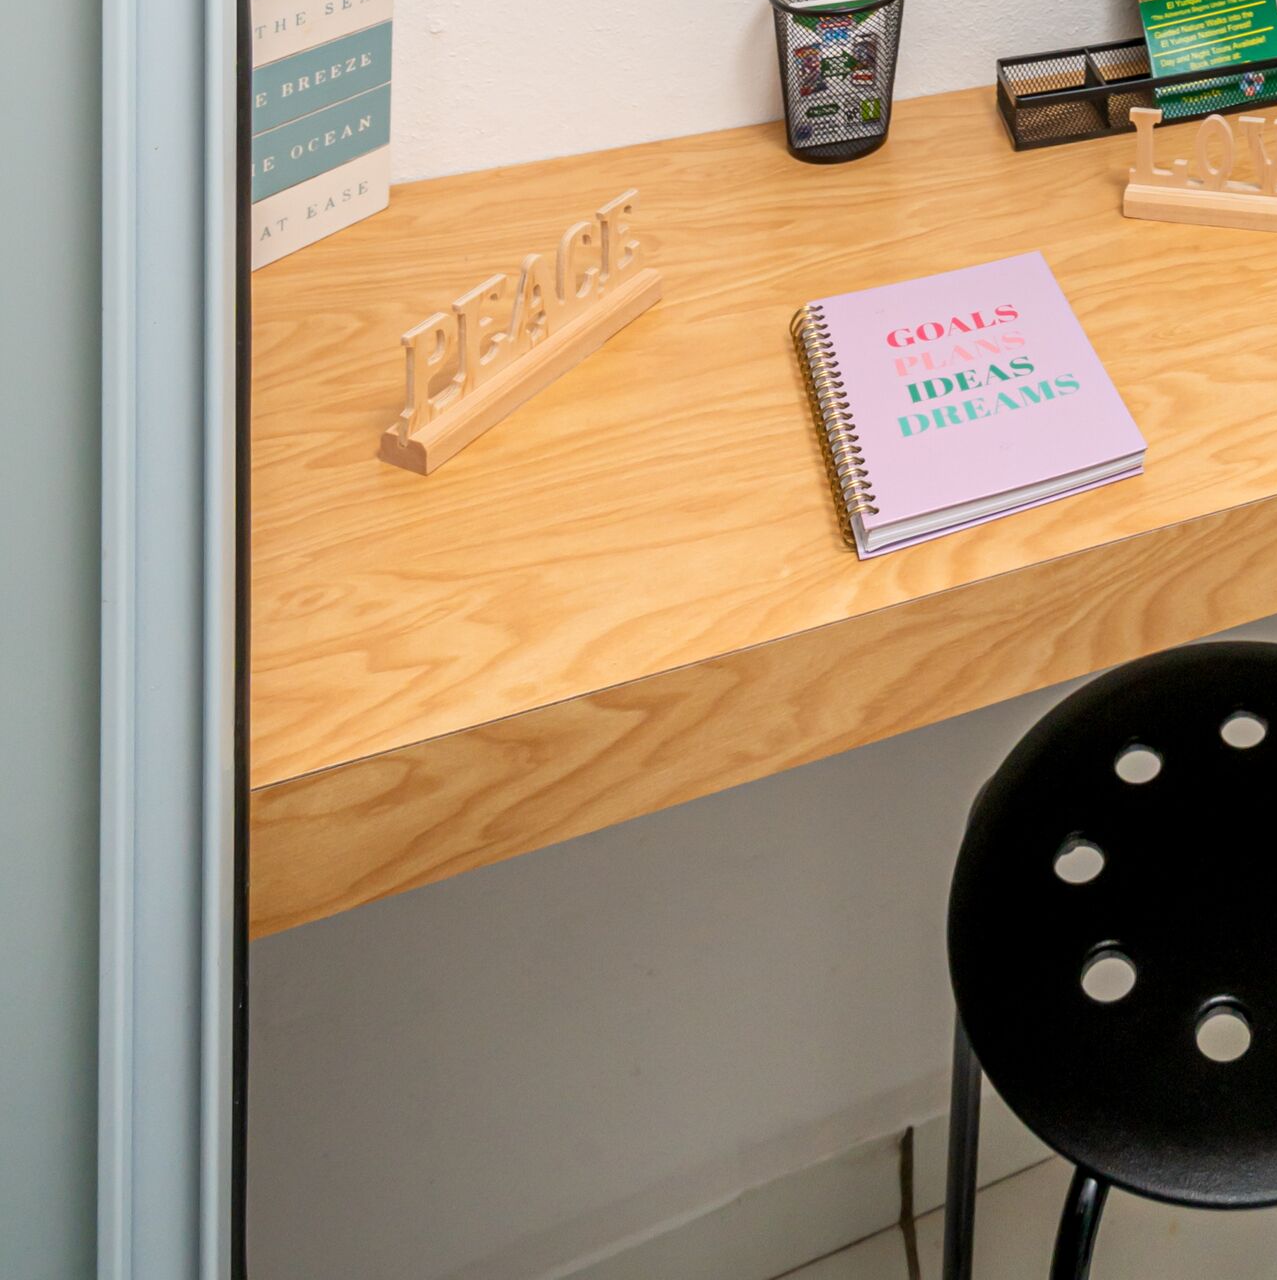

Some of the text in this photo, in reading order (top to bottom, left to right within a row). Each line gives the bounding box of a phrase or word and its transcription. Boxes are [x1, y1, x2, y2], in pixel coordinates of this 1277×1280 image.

[253, 8, 310, 41] THE
[1153, 27, 1181, 40] Guided
[1180, 22, 1206, 33] Nature
[1205, 17, 1228, 27] Walks
[1166, 1, 1174, 10] El
[1197, 26, 1228, 39] National
[280, 52, 373, 99] BREEZE
[1160, 58, 1176, 69] Day
[1175, 54, 1191, 64] and
[1211, 45, 1233, 55] Tours
[290, 114, 373, 160] OCEAN
[258, 180, 371, 242] AT EASE
[400, 188, 642, 448] PEACE
[886, 303, 1020, 349] GOALS
[893, 329, 1026, 377] PLANS
[904, 355, 1036, 405] IDEAS
[896, 372, 1082, 439] DREAMS
